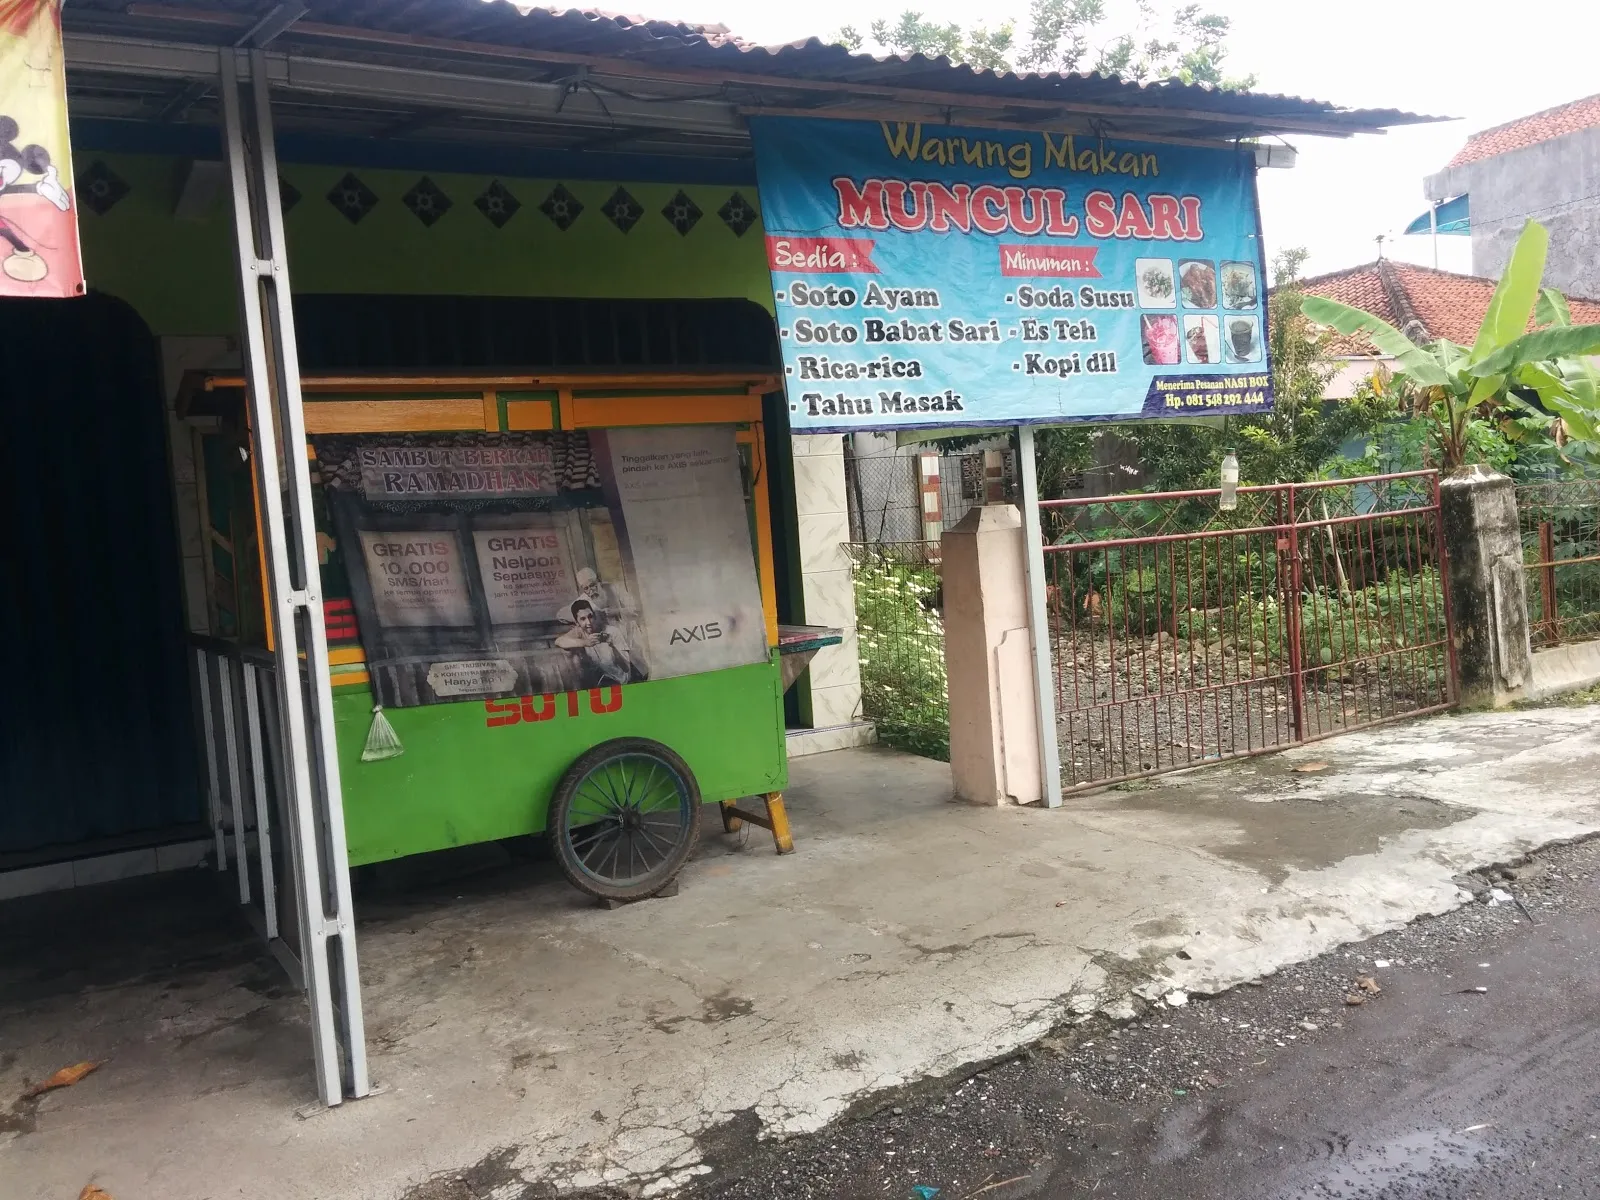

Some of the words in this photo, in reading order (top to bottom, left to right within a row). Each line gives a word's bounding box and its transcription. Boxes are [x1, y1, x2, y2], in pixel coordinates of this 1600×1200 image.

[879, 120, 1031, 178] Warung
[1041, 131, 1159, 177] Makan
[833, 178, 1078, 236] MUNCUL
[1084, 191, 1204, 240] SARI
[791, 283, 856, 306] Soto
[864, 283, 939, 310] Ayam
[1018, 286, 1075, 307] Soda
[1080, 287, 1134, 307] Susu
[795, 320, 858, 343] Soto
[865, 319, 942, 342] Babat
[949, 320, 1000, 342] Sari
[1022, 319, 1049, 341] Es
[1053, 319, 1096, 341] Teh
[799, 356, 922, 380] Rica-rica
[1024, 353, 1081, 378] Kopi
[1086, 352, 1117, 373] dll
[1156, 381, 1195, 391] Menerima
[1195, 379, 1224, 390] Pesanan
[1224, 377, 1248, 388] NASI
[1249, 376, 1269, 387] BOX
[802, 393, 873, 416] Tahu
[878, 390, 963, 414] Masak
[1186, 394, 1203, 406] 081
[1205, 393, 1222, 406] 548
[1223, 393, 1242, 406] 292
[1244, 391, 1264, 405] 444
[362, 449, 453, 468] SAMBUT
[463, 449, 551, 466] BERKAH
[621, 453, 668, 463] Tinggalkan
[622, 464, 652, 474] pindah
[655, 463, 665, 471] ke
[668, 461, 687, 470] AXIS
[383, 470, 540, 494] RAMADHAN
[372, 541, 449, 557] GRATIS
[488, 535, 559, 552] GRATIS
[380, 561, 450, 575] 10.000
[492, 555, 561, 571] Nelpon
[387, 576, 449, 588] SMS/hari
[493, 569, 565, 583] Sepuasnya
[669, 622, 722, 645] AXIS
[444, 678, 479, 687] Hanya
